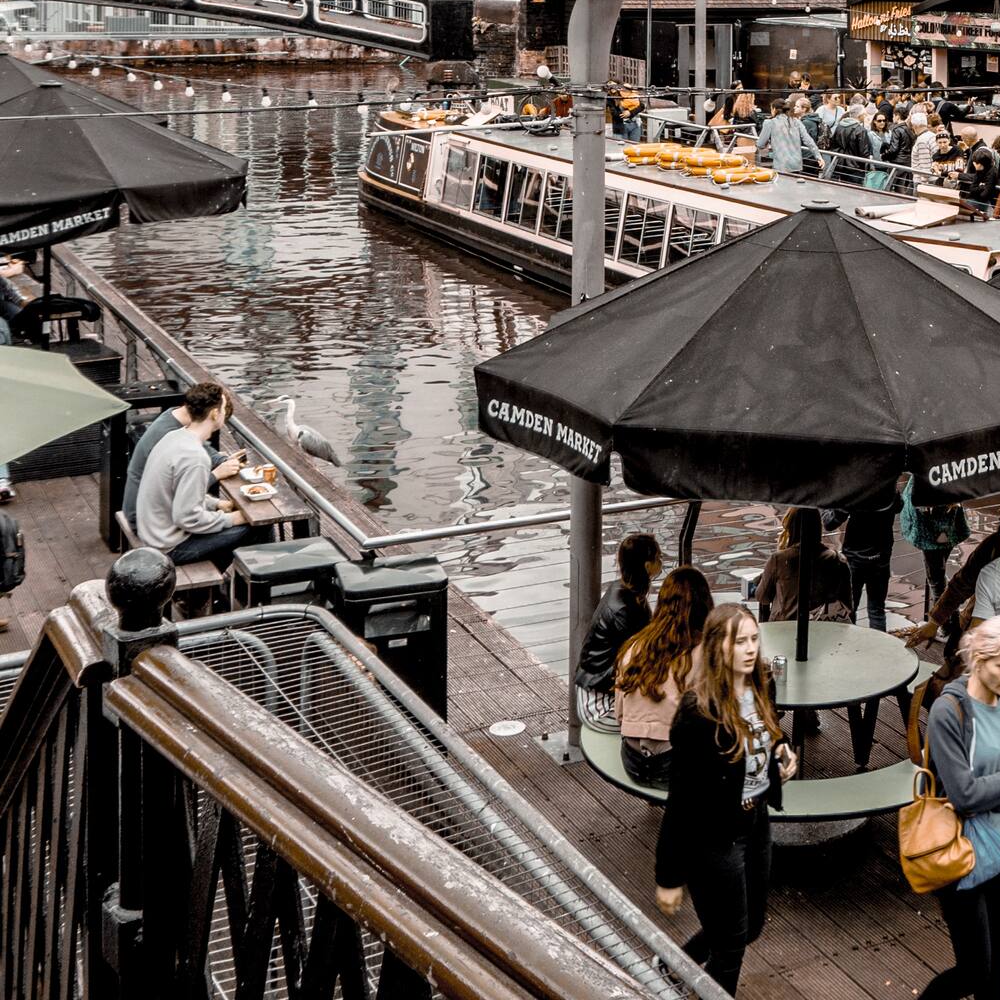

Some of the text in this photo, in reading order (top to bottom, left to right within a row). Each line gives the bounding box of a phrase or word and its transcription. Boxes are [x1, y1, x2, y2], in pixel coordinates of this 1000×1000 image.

[891, 5, 911, 20] Fries
[52, 207, 111, 233] MARKET
[487, 399, 602, 464] CAMDEN MARKET
